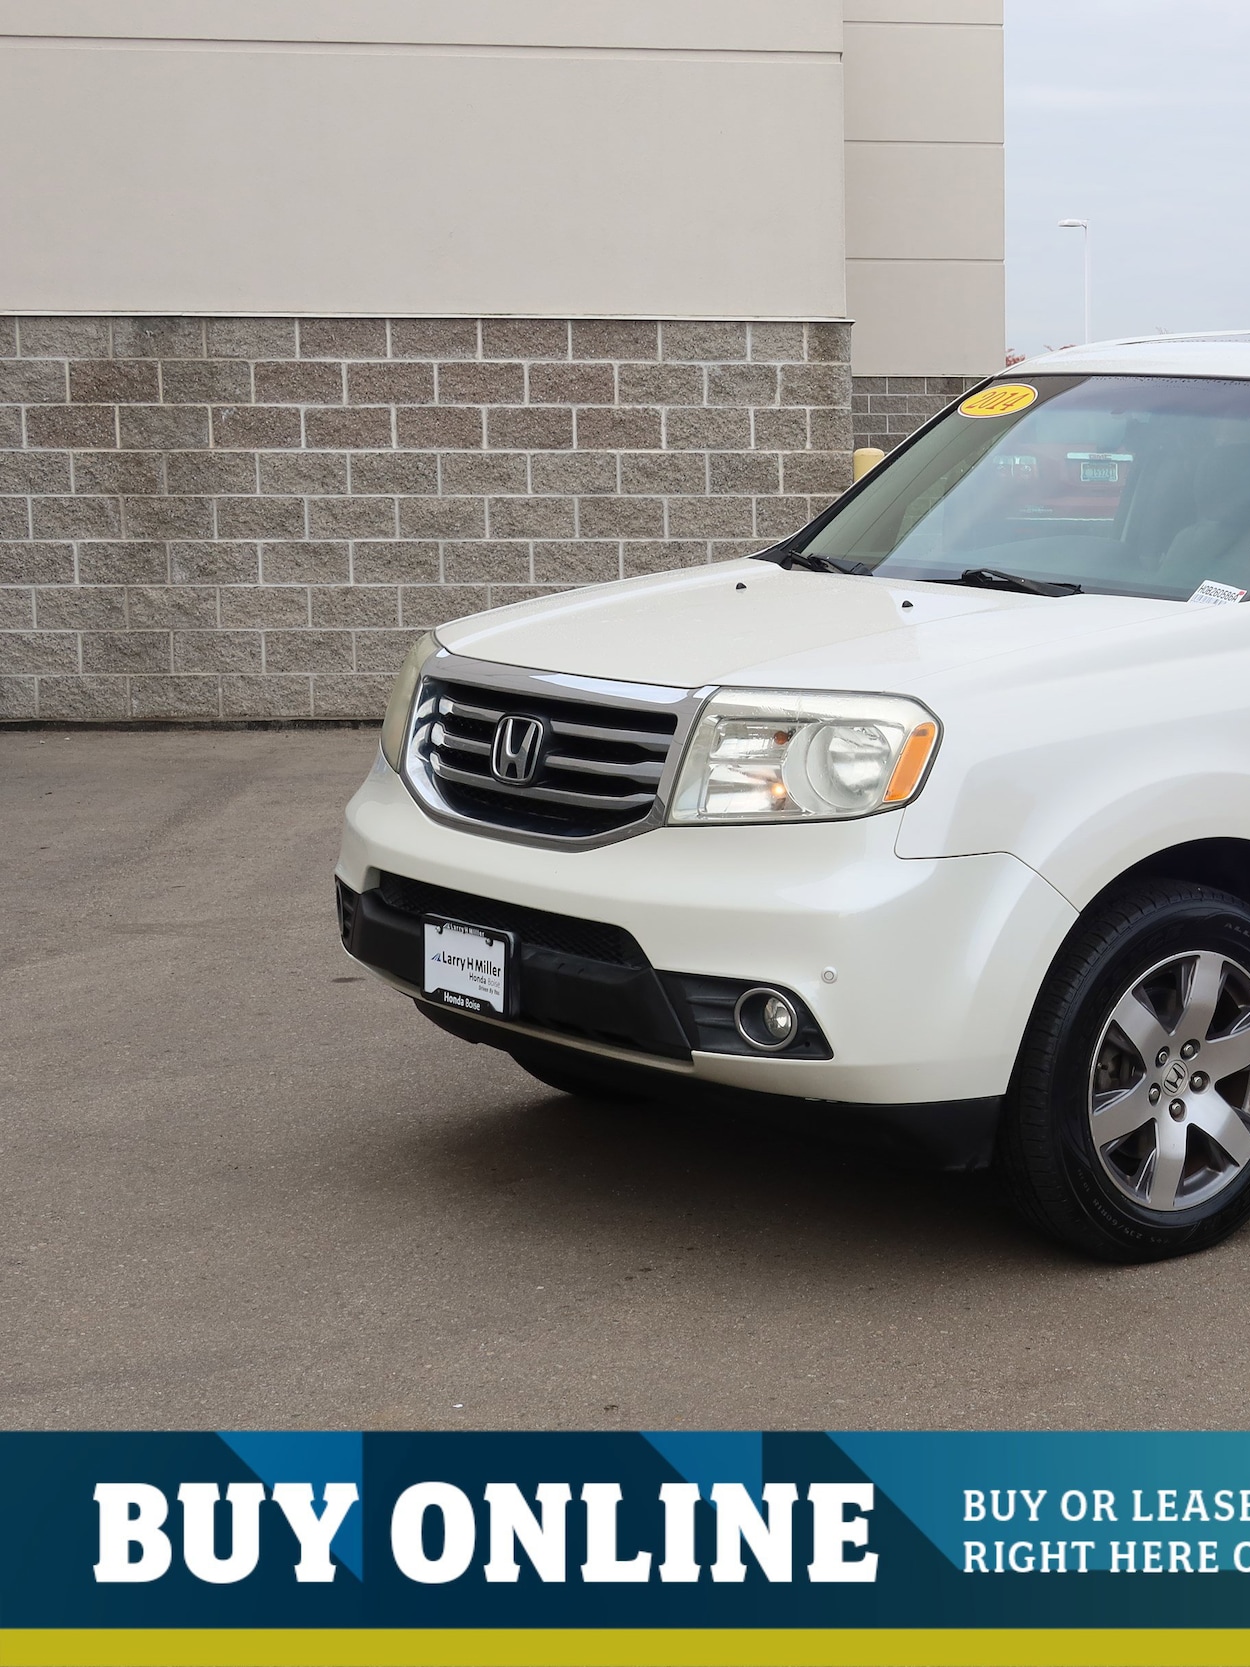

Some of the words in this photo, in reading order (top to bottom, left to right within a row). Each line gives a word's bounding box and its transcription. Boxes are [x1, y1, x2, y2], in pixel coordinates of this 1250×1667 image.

[965, 391, 1030, 411] 2014
[442, 951, 466, 971] Larry
[467, 957, 474, 970] H
[475, 959, 501, 977] Miller
[469, 973, 487, 985] Honda
[487, 977, 501, 988] Boise
[443, 991, 464, 1007] Honda
[465, 998, 481, 1011] Boise
